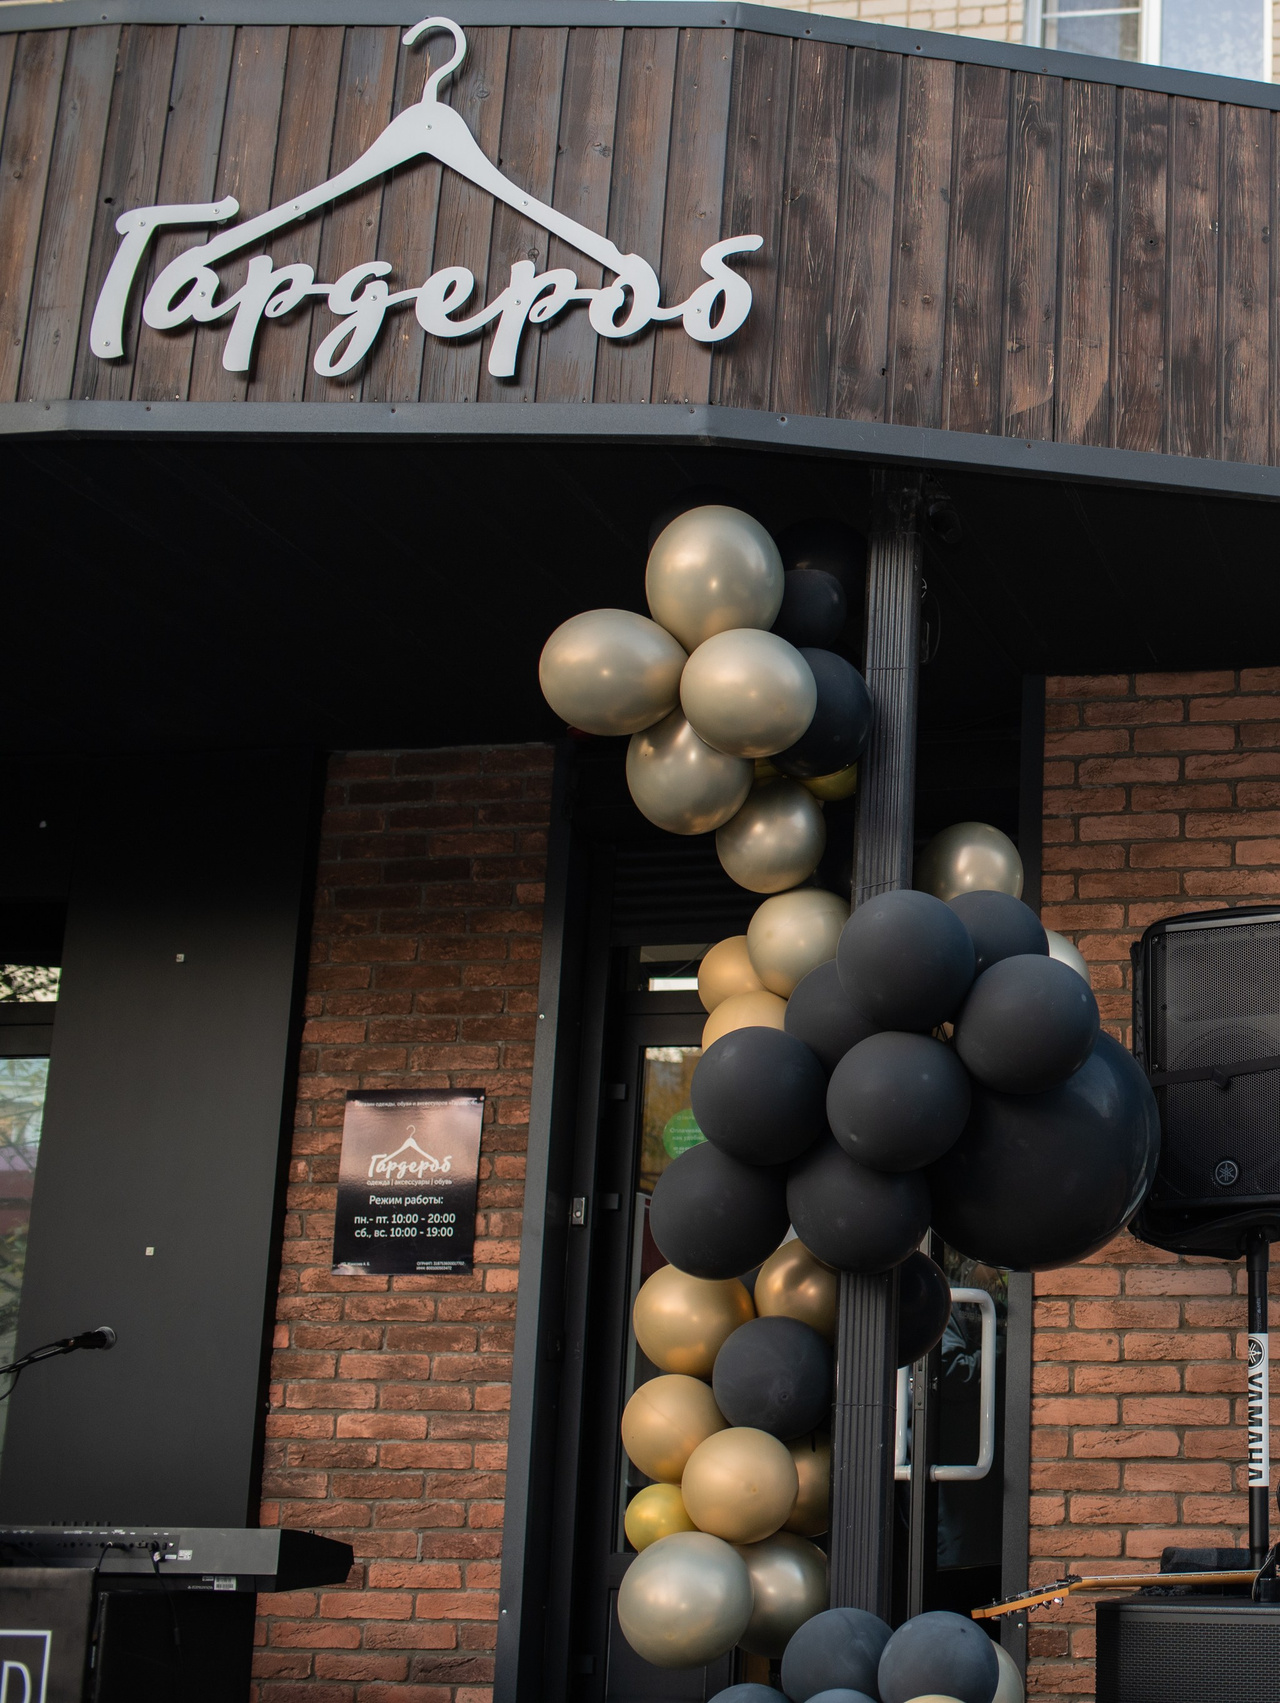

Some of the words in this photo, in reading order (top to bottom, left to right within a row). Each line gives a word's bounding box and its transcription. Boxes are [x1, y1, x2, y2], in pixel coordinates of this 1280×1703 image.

[90, 195, 764, 378] Гардероб
[368, 1153, 452, 1179] Гардероб
[369, 1195, 402, 1205] Режим
[404, 1194, 444, 1206] работы:
[375, 1216, 389, 1224] пт.
[391, 1213, 419, 1224] 10:00
[427, 1213, 456, 1224] 20:00
[354, 1228, 372, 1239] сб.,
[374, 1229, 388, 1238] вс.
[390, 1227, 417, 1238] 10:00
[426, 1227, 454, 1238] 19:00
